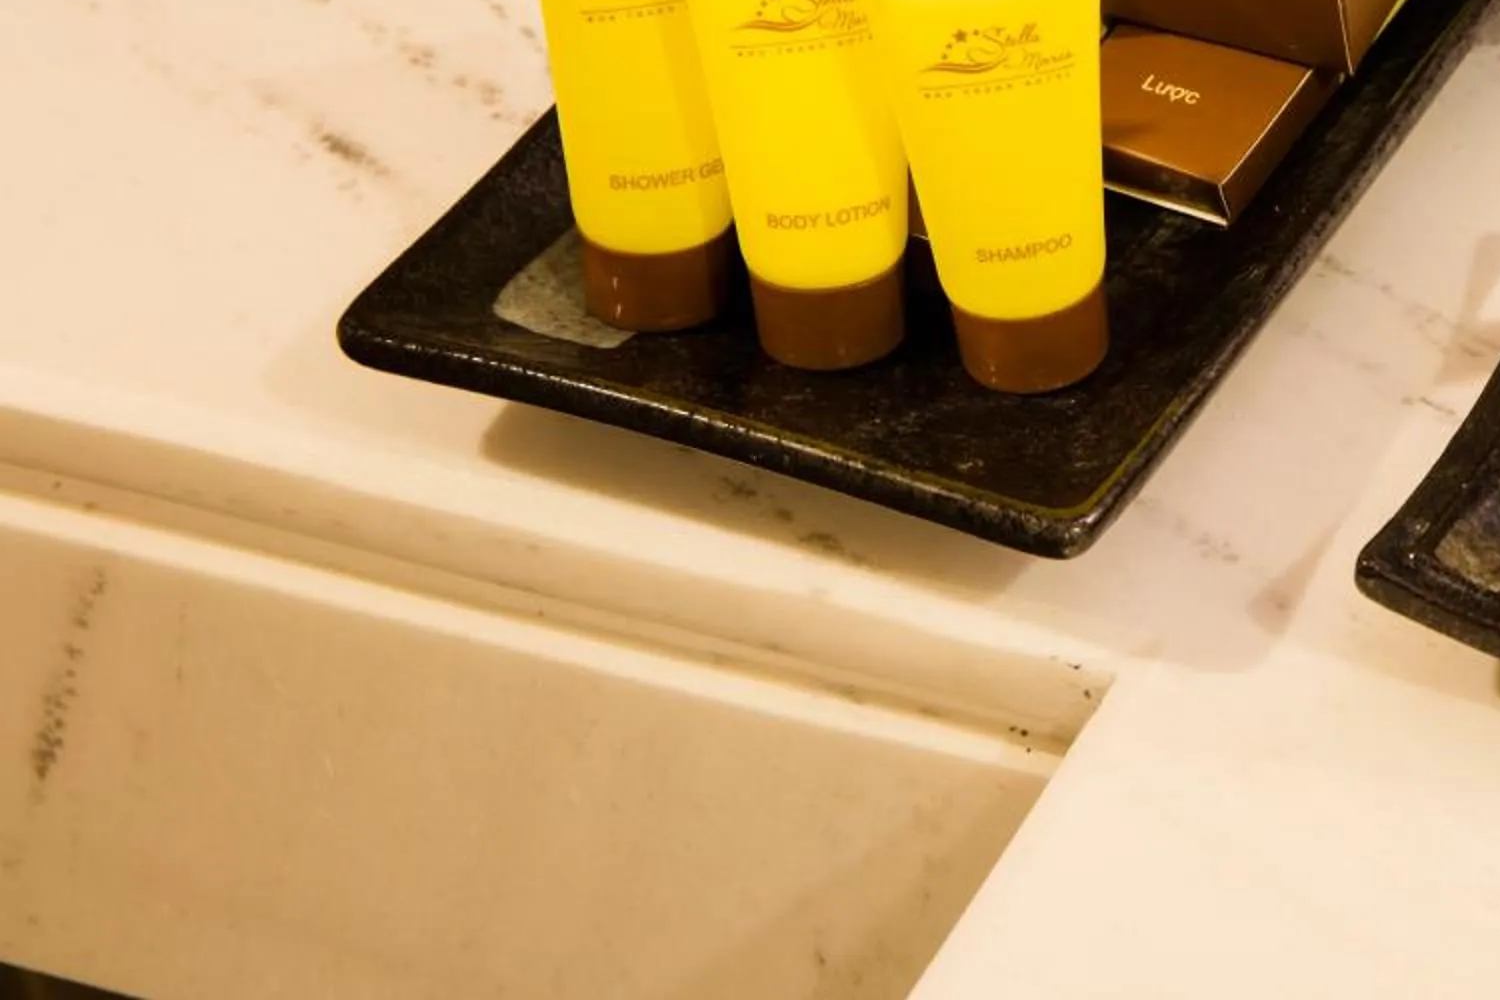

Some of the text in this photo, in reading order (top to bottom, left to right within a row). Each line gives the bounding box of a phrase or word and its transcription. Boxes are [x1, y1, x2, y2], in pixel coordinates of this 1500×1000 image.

[609, 157, 725, 191] SHOWER GE
[766, 196, 892, 230] BODY LOTION
[975, 233, 1073, 263] SHAMPOO
